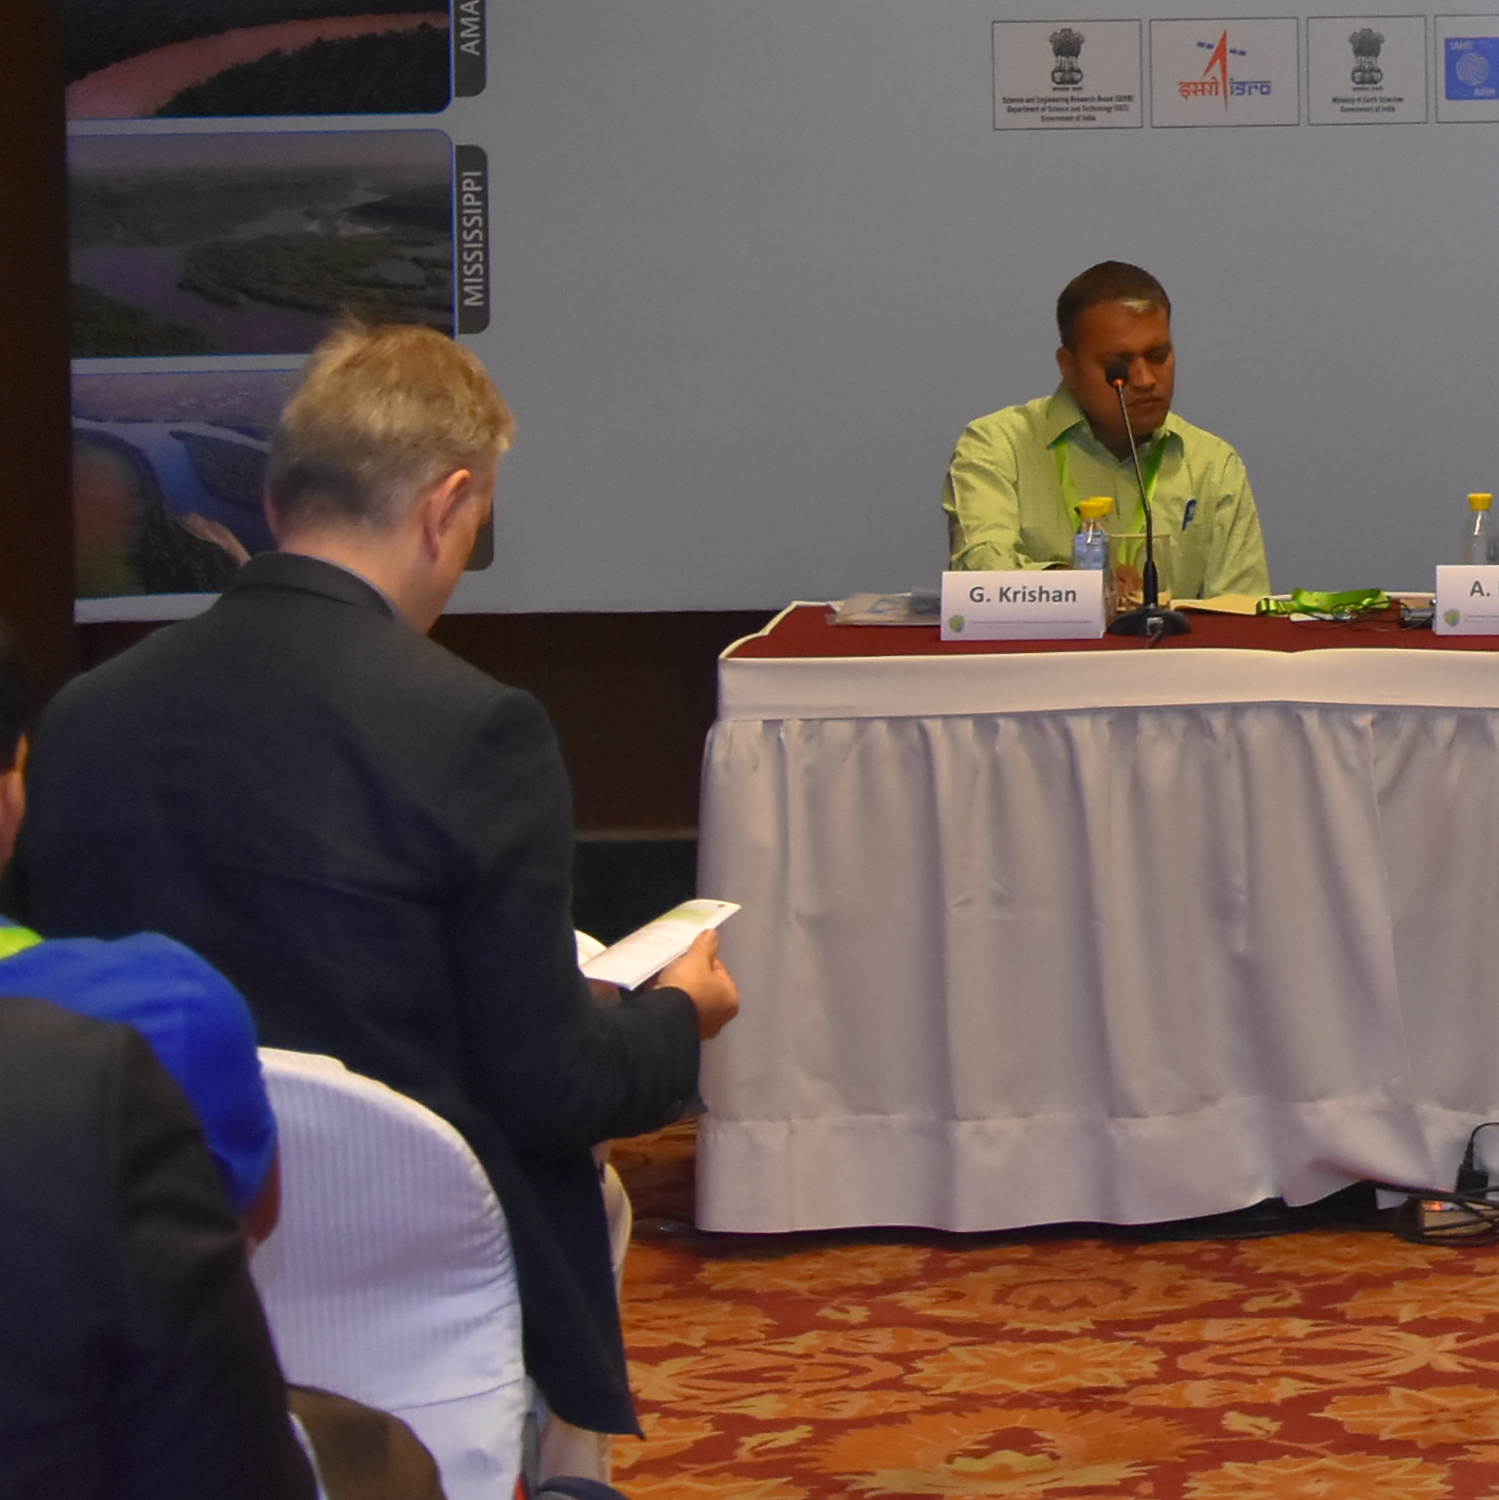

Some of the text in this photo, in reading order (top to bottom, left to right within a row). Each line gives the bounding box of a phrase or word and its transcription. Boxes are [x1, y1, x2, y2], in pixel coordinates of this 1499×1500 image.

[1229, 78, 1272, 96] isro
[462, 171, 483, 308] MISSISSIPPI
[969, 583, 1077, 603] G. Krishan
[1469, 580, 1491, 597] A.
